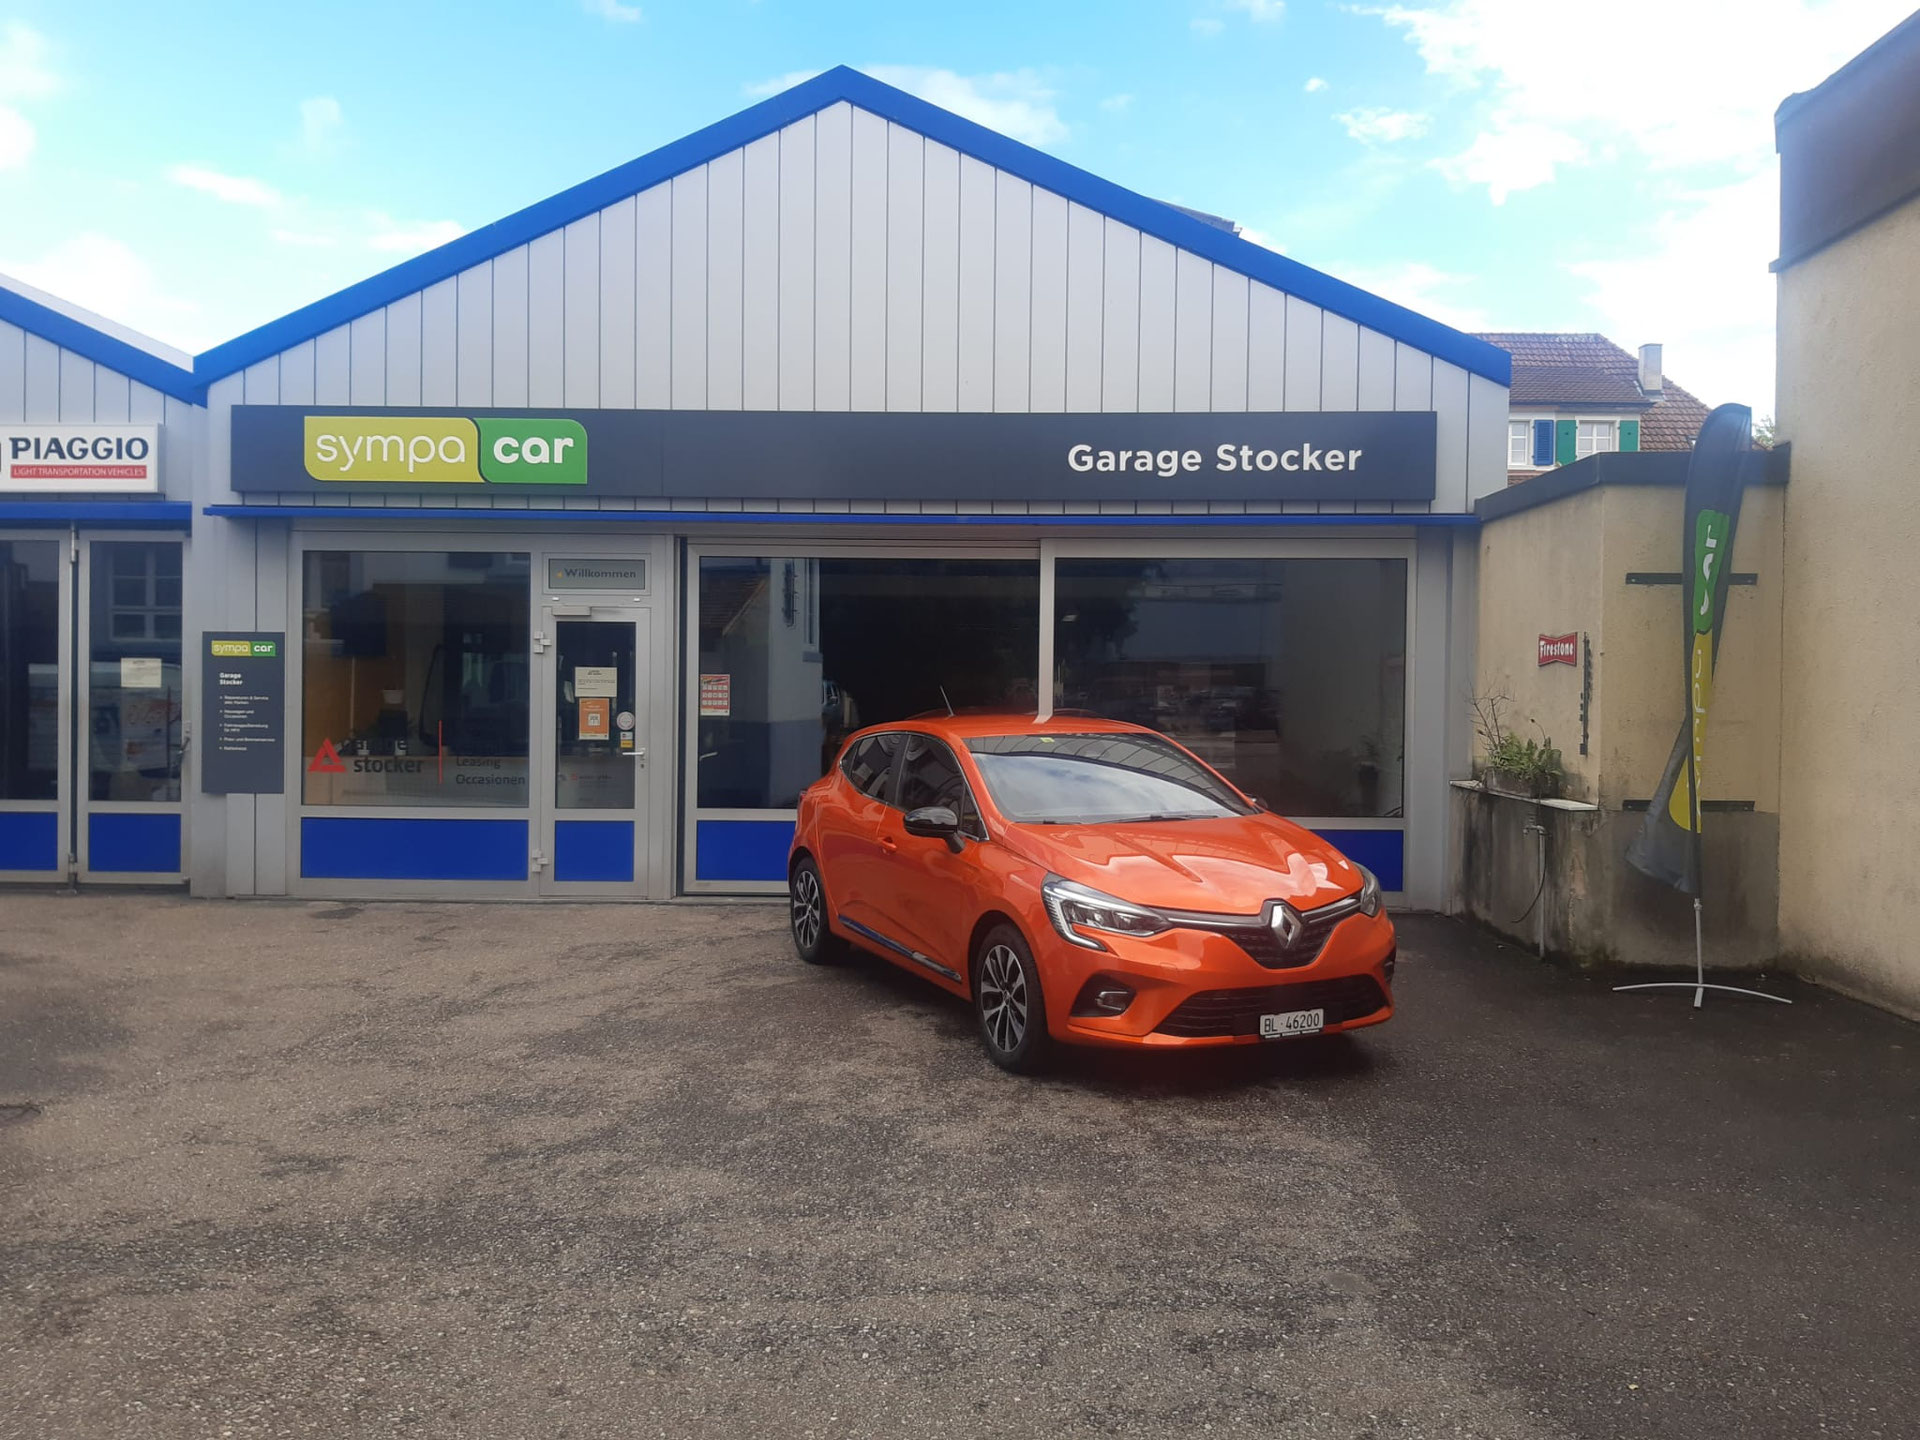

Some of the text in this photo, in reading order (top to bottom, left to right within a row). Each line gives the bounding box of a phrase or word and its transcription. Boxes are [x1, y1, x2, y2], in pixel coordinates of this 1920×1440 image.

[8, 437, 149, 460] PIAGGIO
[316, 434, 574, 473] sympa car
[1067, 443, 1362, 477] Garage Stocker
[13, 468, 144, 476] LIGHT TRANSPORTATION VEHICLES
[564, 568, 636, 578] Willkommen
[213, 644, 249, 654] sympa
[1540, 640, 1574, 658] Firestone
[353, 757, 424, 773] stocker
[456, 757, 501, 769] Leasing
[456, 773, 525, 785] Occasionen
[1264, 1013, 1319, 1032] BL 46200
